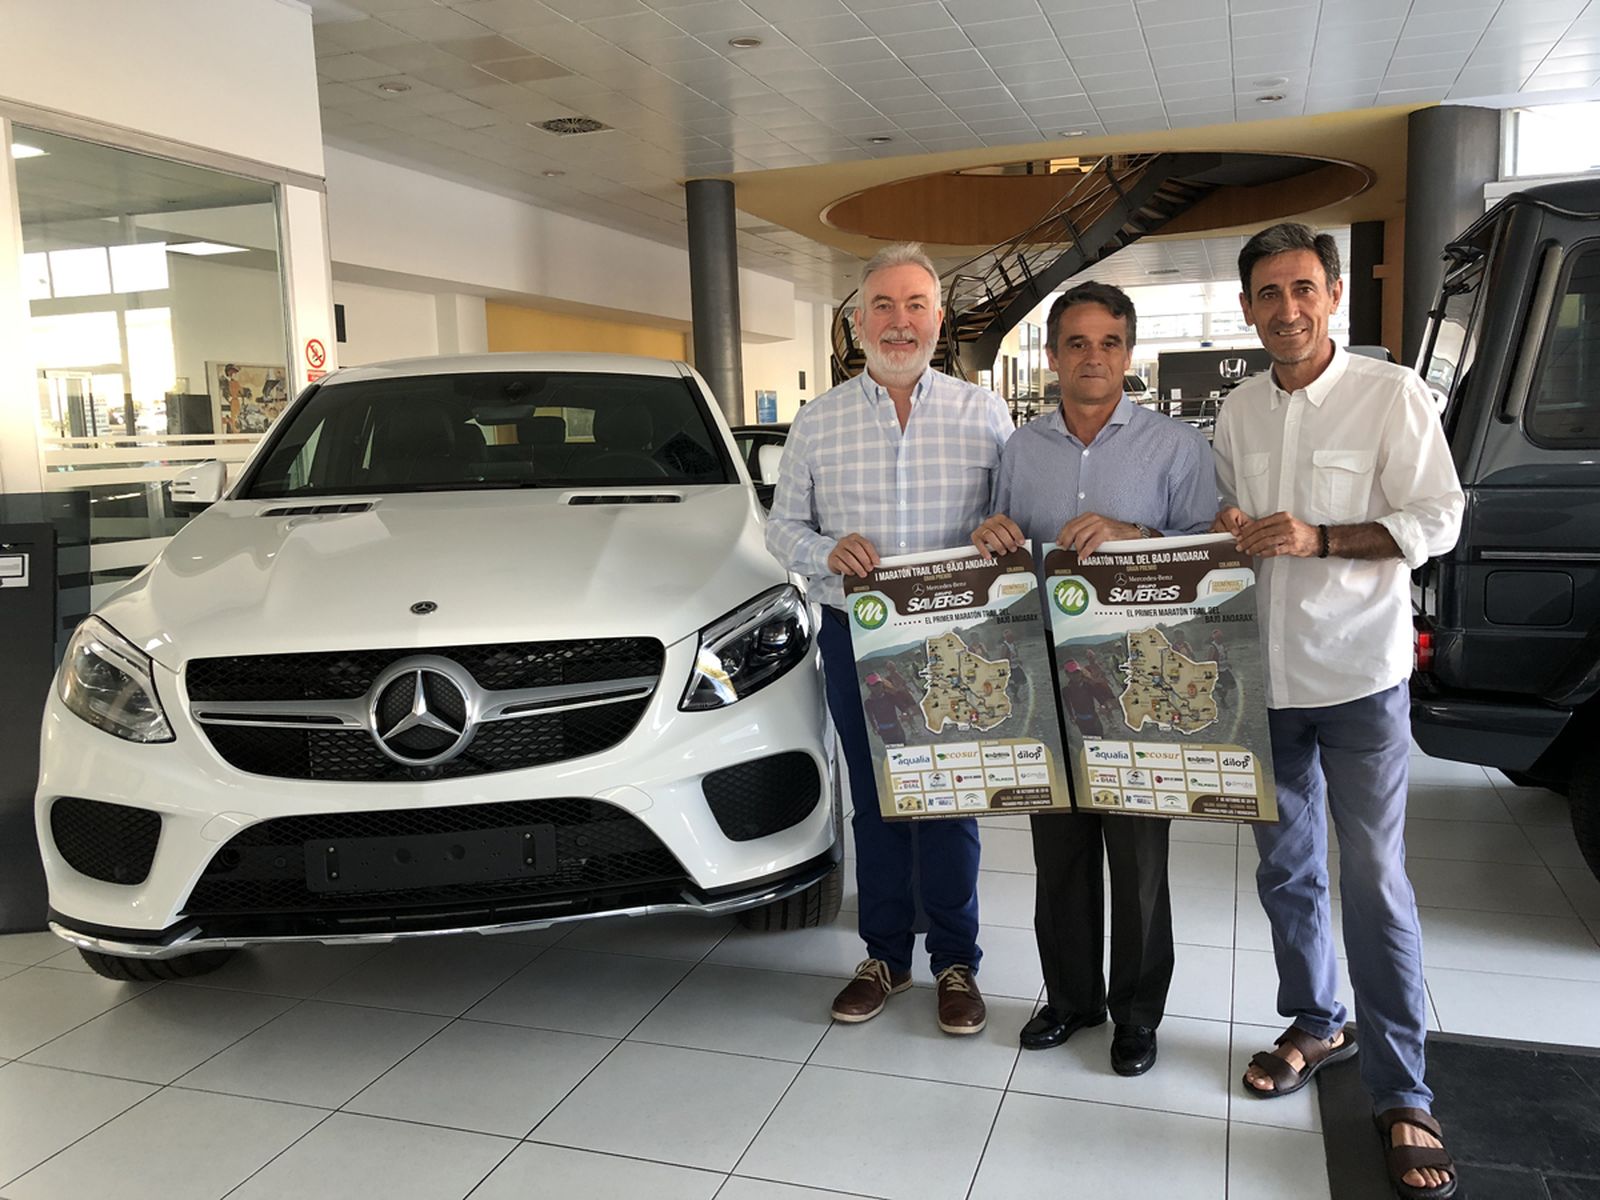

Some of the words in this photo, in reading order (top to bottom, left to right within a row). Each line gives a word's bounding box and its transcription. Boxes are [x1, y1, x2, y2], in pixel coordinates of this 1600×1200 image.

[1082, 553, 1114, 565] MARATÓN
[1115, 553, 1134, 565] TRAIL
[1136, 552, 1150, 564] DEL
[1152, 552, 1170, 563] BAJO
[1172, 550, 1209, 560] ANDARAX
[878, 568, 911, 580] MARATÓN
[911, 565, 933, 576] TRAIL
[932, 563, 945, 574] DEL
[946, 561, 964, 572] BAJO
[964, 557, 998, 569] ANDARAX
[1128, 574, 1172, 582] Mercedes-Benz
[1109, 585, 1180, 602] SAVERES
[906, 590, 974, 612] SAVERES
[924, 616, 931, 624] EL
[932, 614, 953, 623] PRIMER
[954, 610, 981, 621] MARATÓN
[981, 609, 998, 618] TRAIL
[998, 608, 1010, 617] DEL
[1134, 608, 1157, 616] PRIMER
[1158, 606, 1188, 615] MARATÓN
[1189, 606, 1206, 615] TRAIL
[1206, 606, 1220, 614] DEL
[996, 615, 1011, 624] BAJO
[1205, 615, 1221, 623] BAJO
[1222, 613, 1253, 622] ANDARAX
[898, 753, 930, 766] aqualia
[943, 749, 977, 760] ecosur
[1016, 749, 1041, 760] dilop
[1095, 748, 1128, 760] aqualia
[1144, 750, 1180, 760] ecosur
[1222, 757, 1248, 768] dilop
